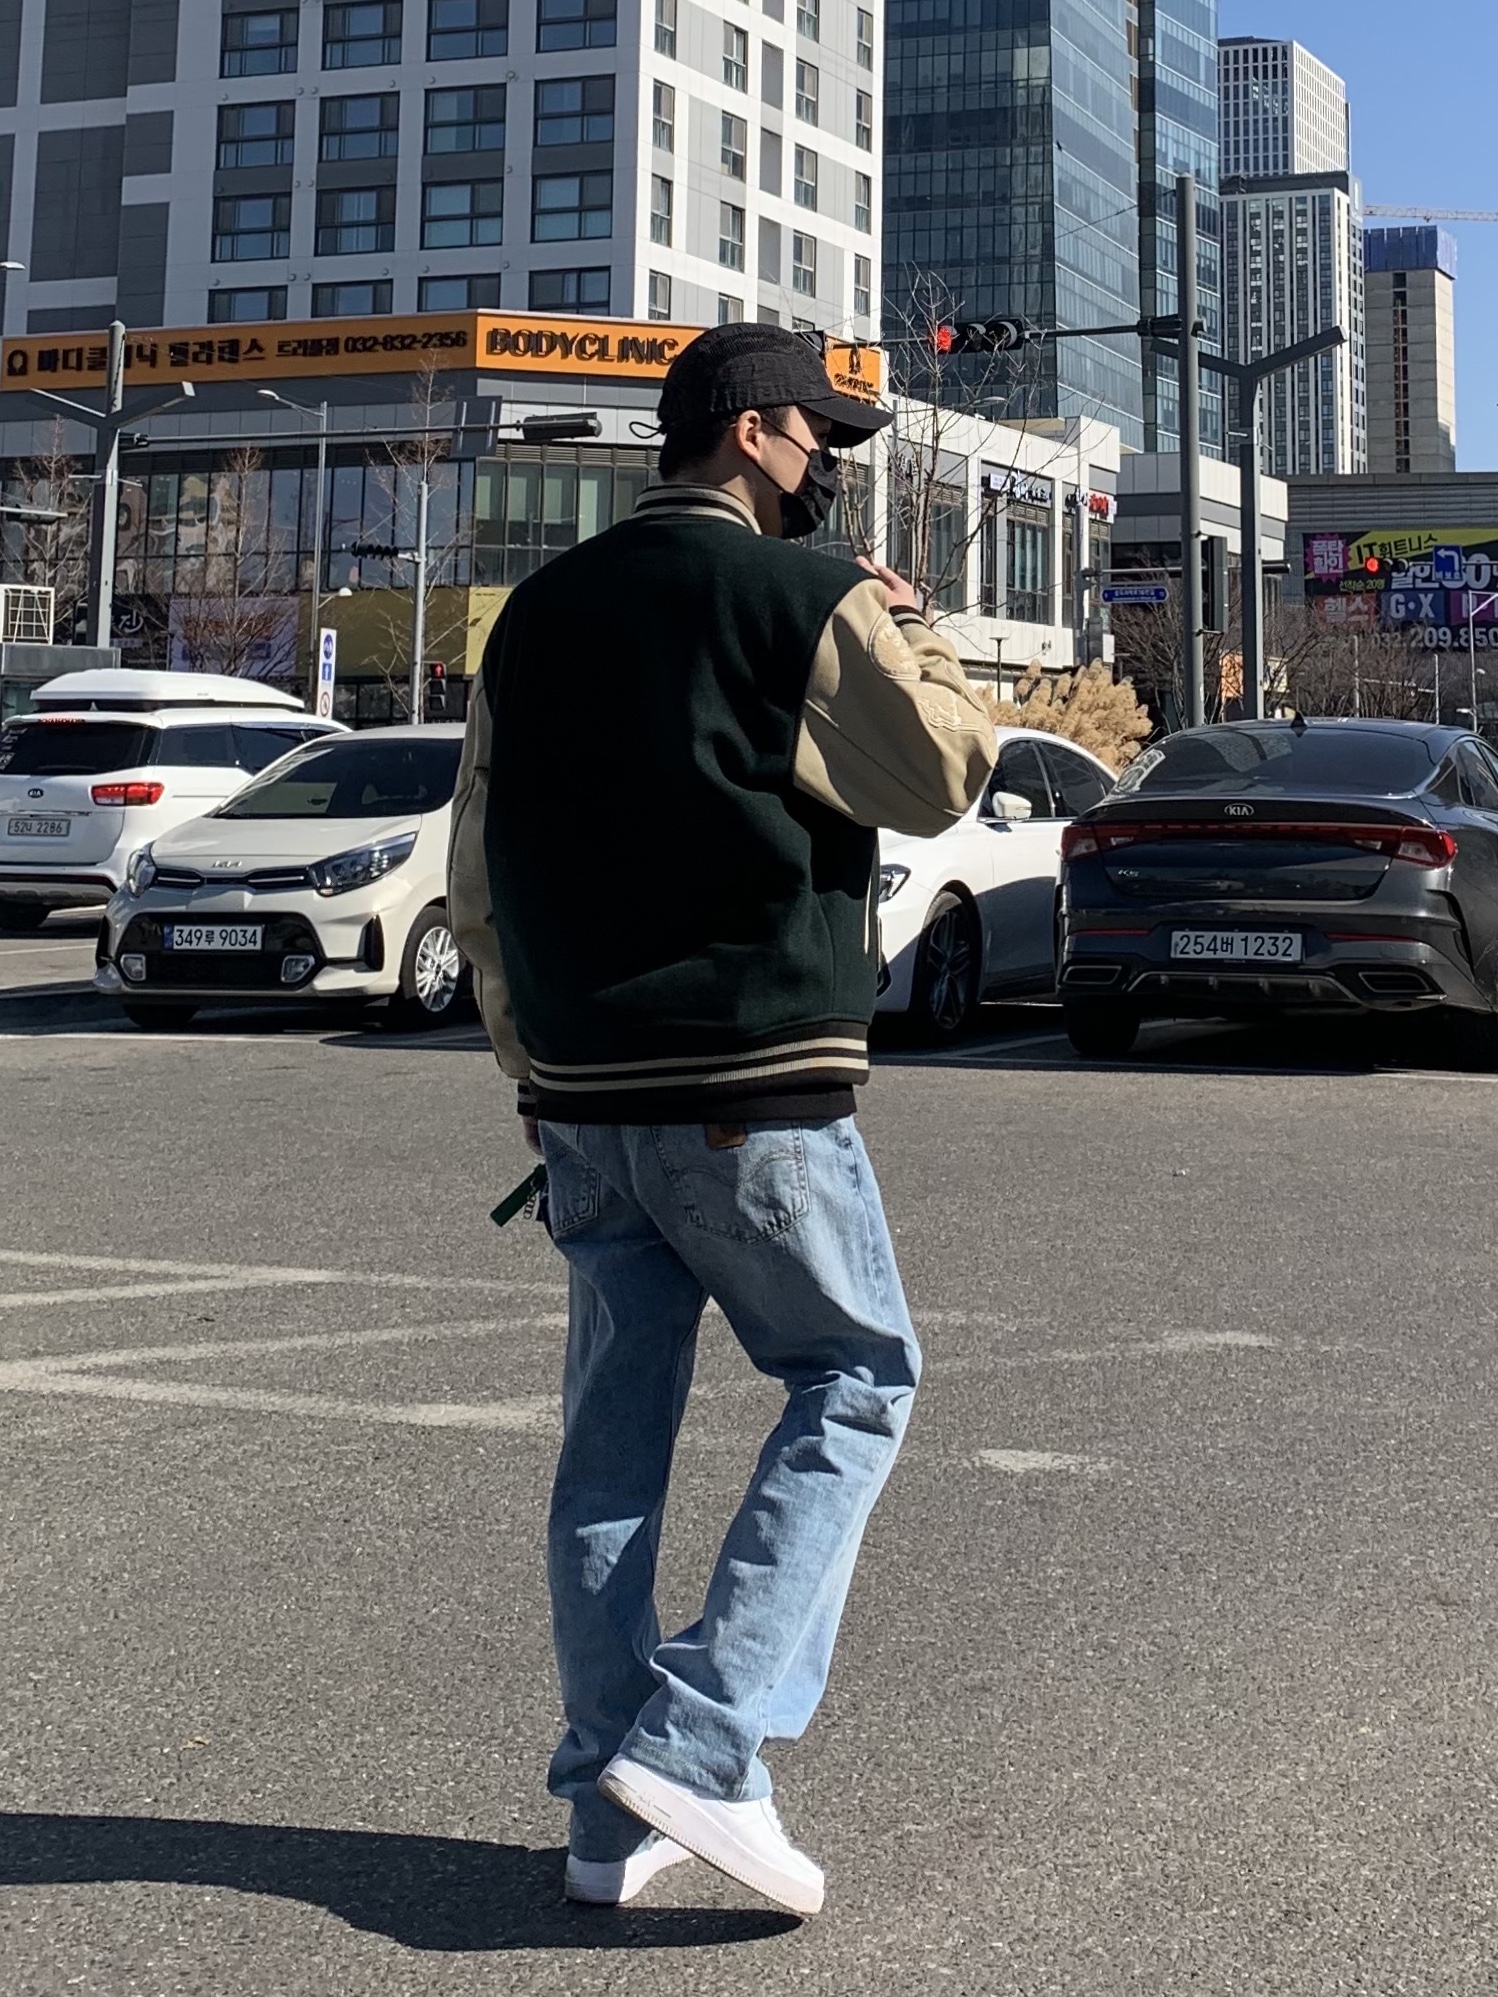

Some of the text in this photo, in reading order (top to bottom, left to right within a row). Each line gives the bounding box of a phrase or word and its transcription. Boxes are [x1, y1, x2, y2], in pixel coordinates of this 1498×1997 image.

[486, 327, 680, 367] BODYCLINIC
[1228, 805, 1250, 816] KIA
[175, 928, 257, 946] 349루 9034
[1179, 934, 1293, 957] 254버 1232
